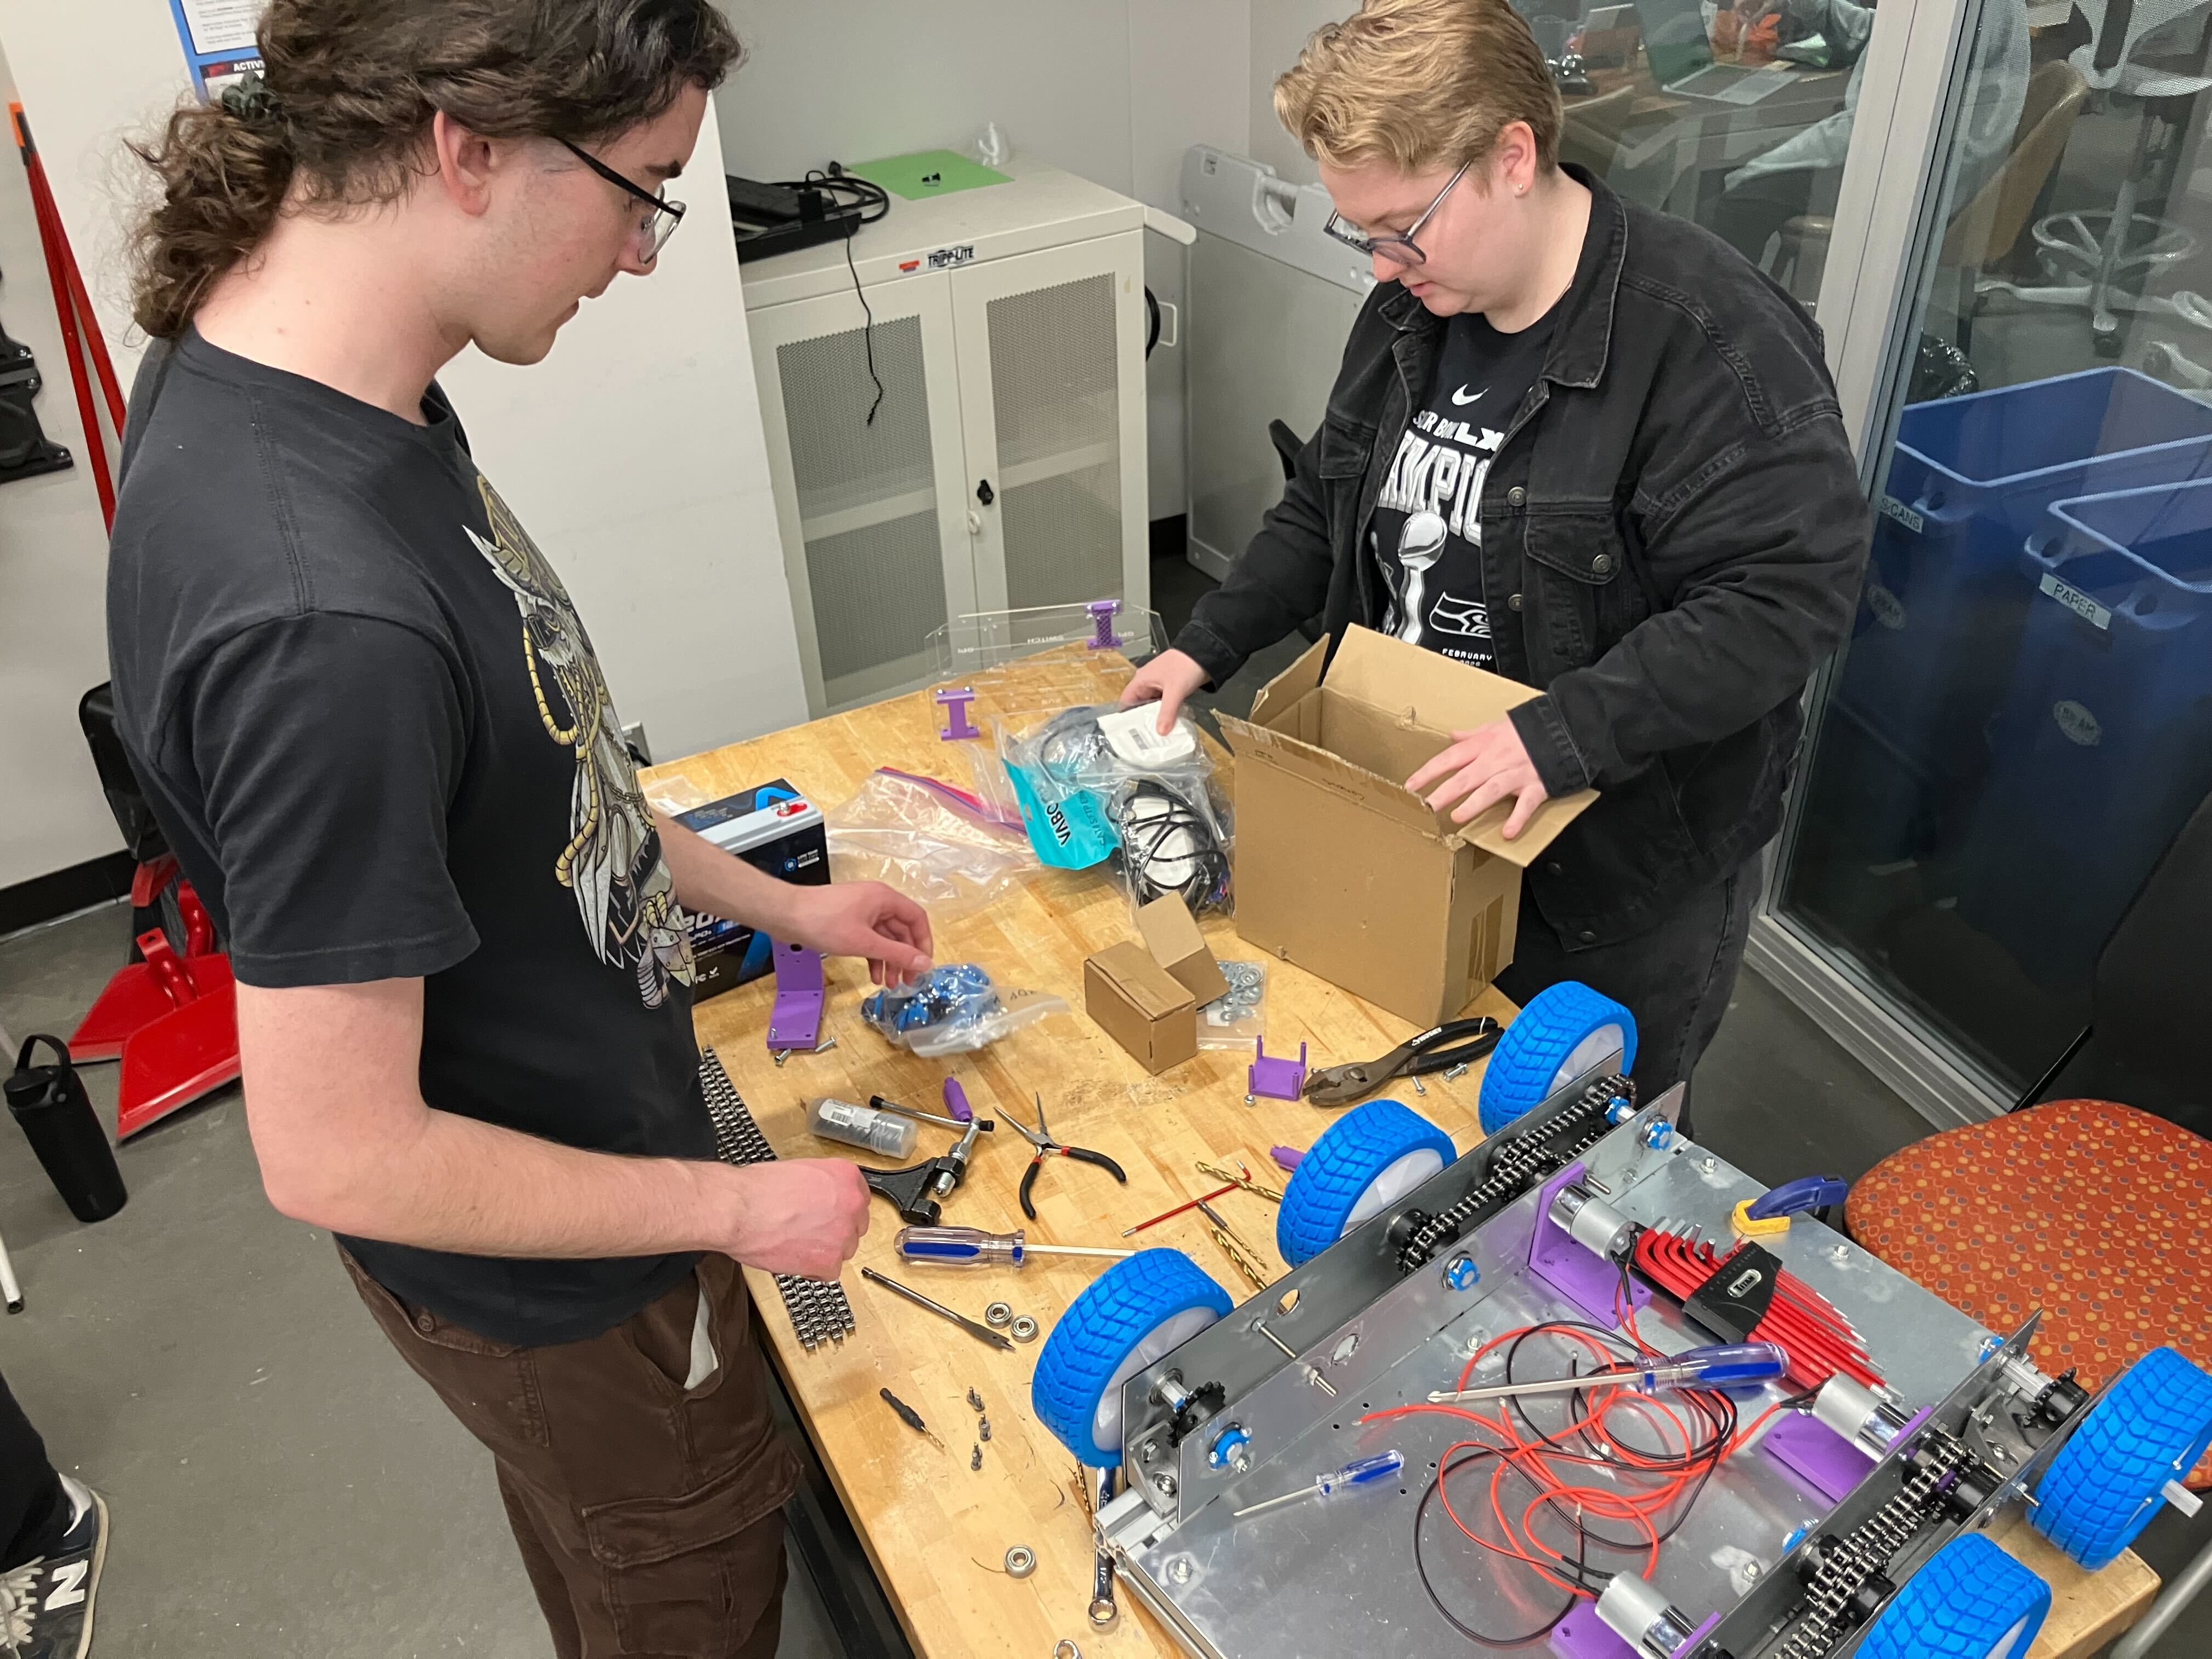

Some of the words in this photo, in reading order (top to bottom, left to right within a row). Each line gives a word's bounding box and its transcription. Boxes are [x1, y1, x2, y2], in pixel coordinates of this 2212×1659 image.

[2053, 583, 2096, 619] PAPER
[1442, 648, 1492, 661] FEBRUARY
[44, 1559, 88, 1611] N
